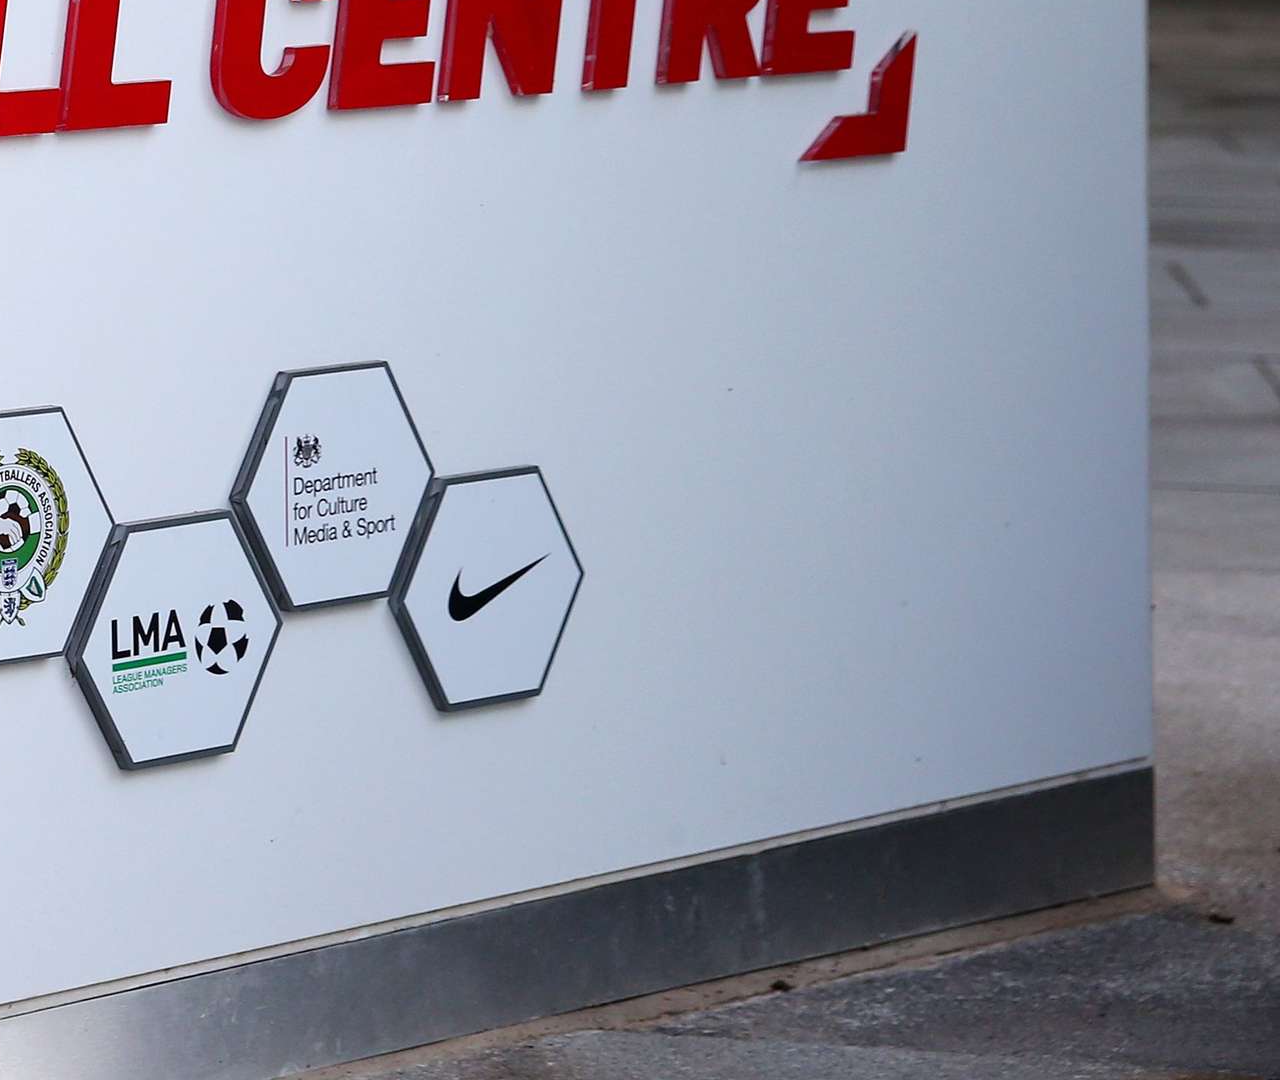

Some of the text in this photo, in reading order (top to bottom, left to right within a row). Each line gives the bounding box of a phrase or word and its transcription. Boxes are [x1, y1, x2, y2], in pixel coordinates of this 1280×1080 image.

[293, 467, 378, 497] Department
[293, 496, 369, 520] for Culture
[35, 491, 54, 566] ASSOCIATION
[293, 514, 396, 546] Media & Sport
[111, 609, 186, 660] LMA
[112, 663, 188, 685] LEAGUE MANAGERS
[112, 677, 164, 694] ASSOCIATION
